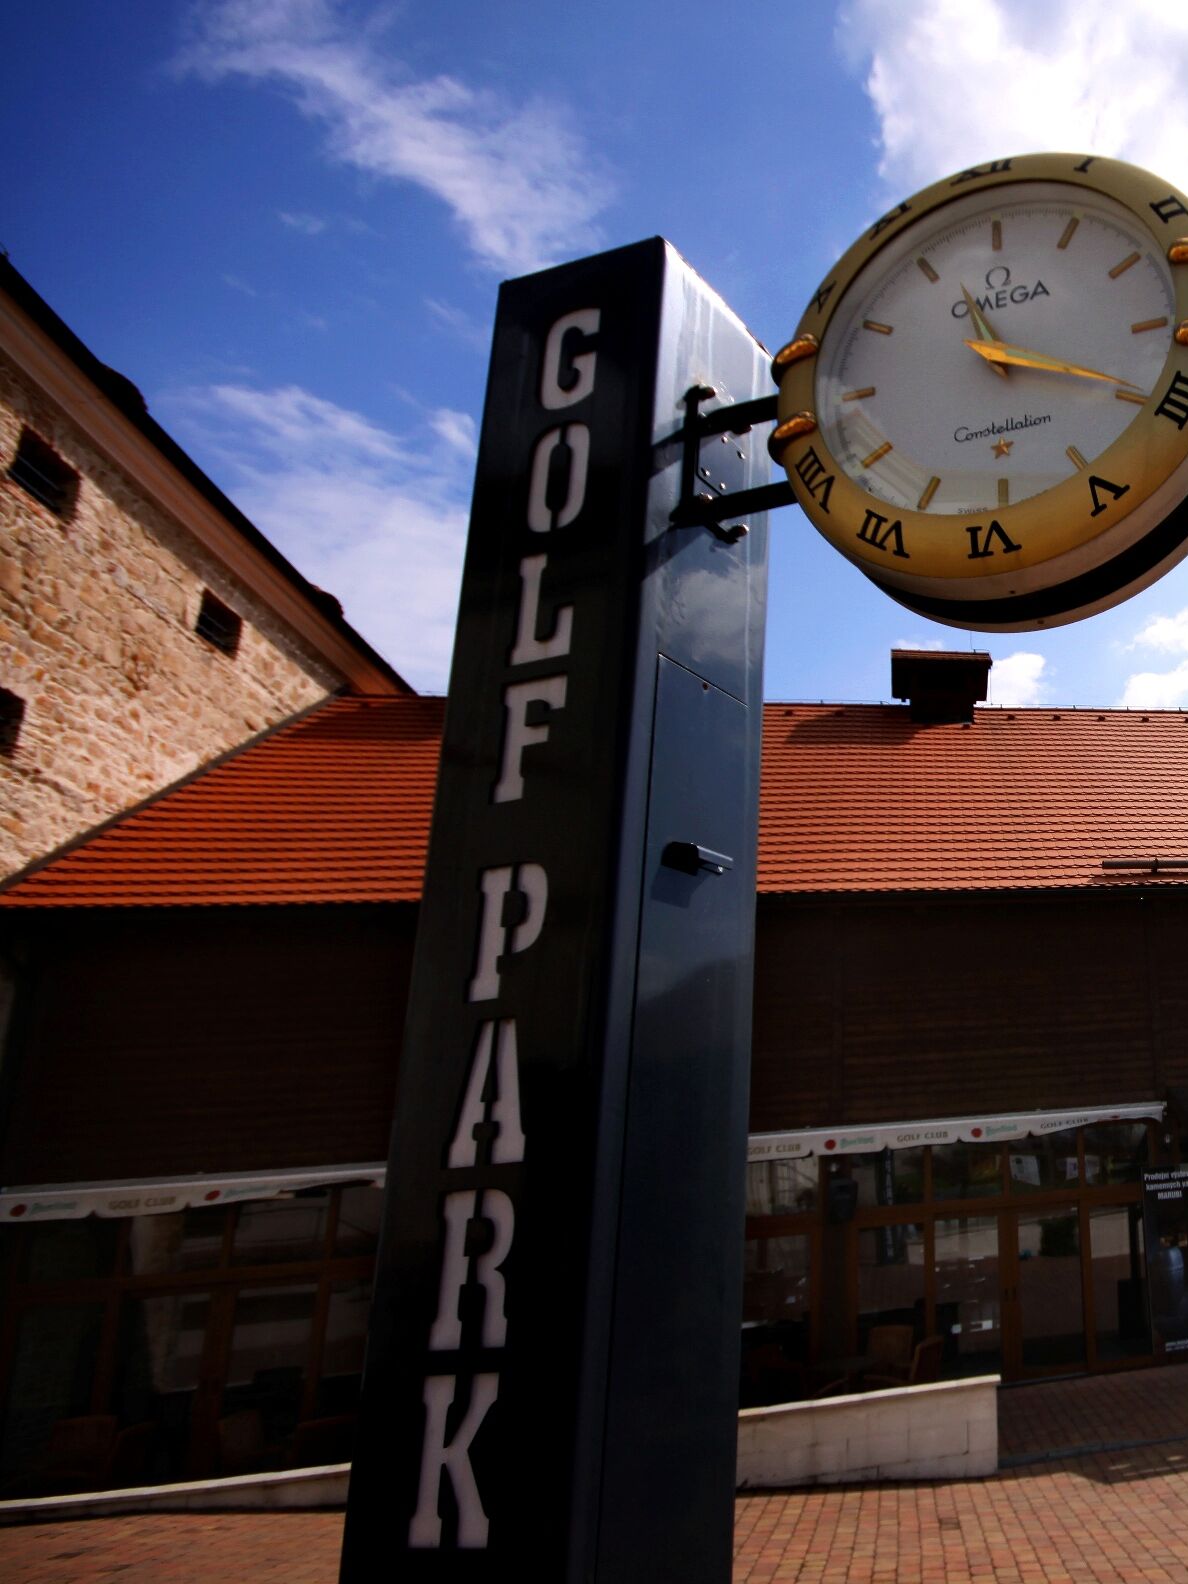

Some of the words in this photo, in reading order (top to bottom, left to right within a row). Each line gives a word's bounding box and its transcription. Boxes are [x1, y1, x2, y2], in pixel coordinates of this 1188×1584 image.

[951, 279, 1050, 319] OMEGA
[953, 413, 1052, 443] Constellation
[794, 445, 836, 515] VIII
[1088, 475, 1131, 518] V
[856, 508, 910, 559] VII
[965, 519, 1022, 559] VI
[495, 307, 601, 804] GOLF
[896, 1133, 921, 1143] GOLF
[924, 1130, 949, 1140] CLUB
[406, 861, 549, 1550] PARK
